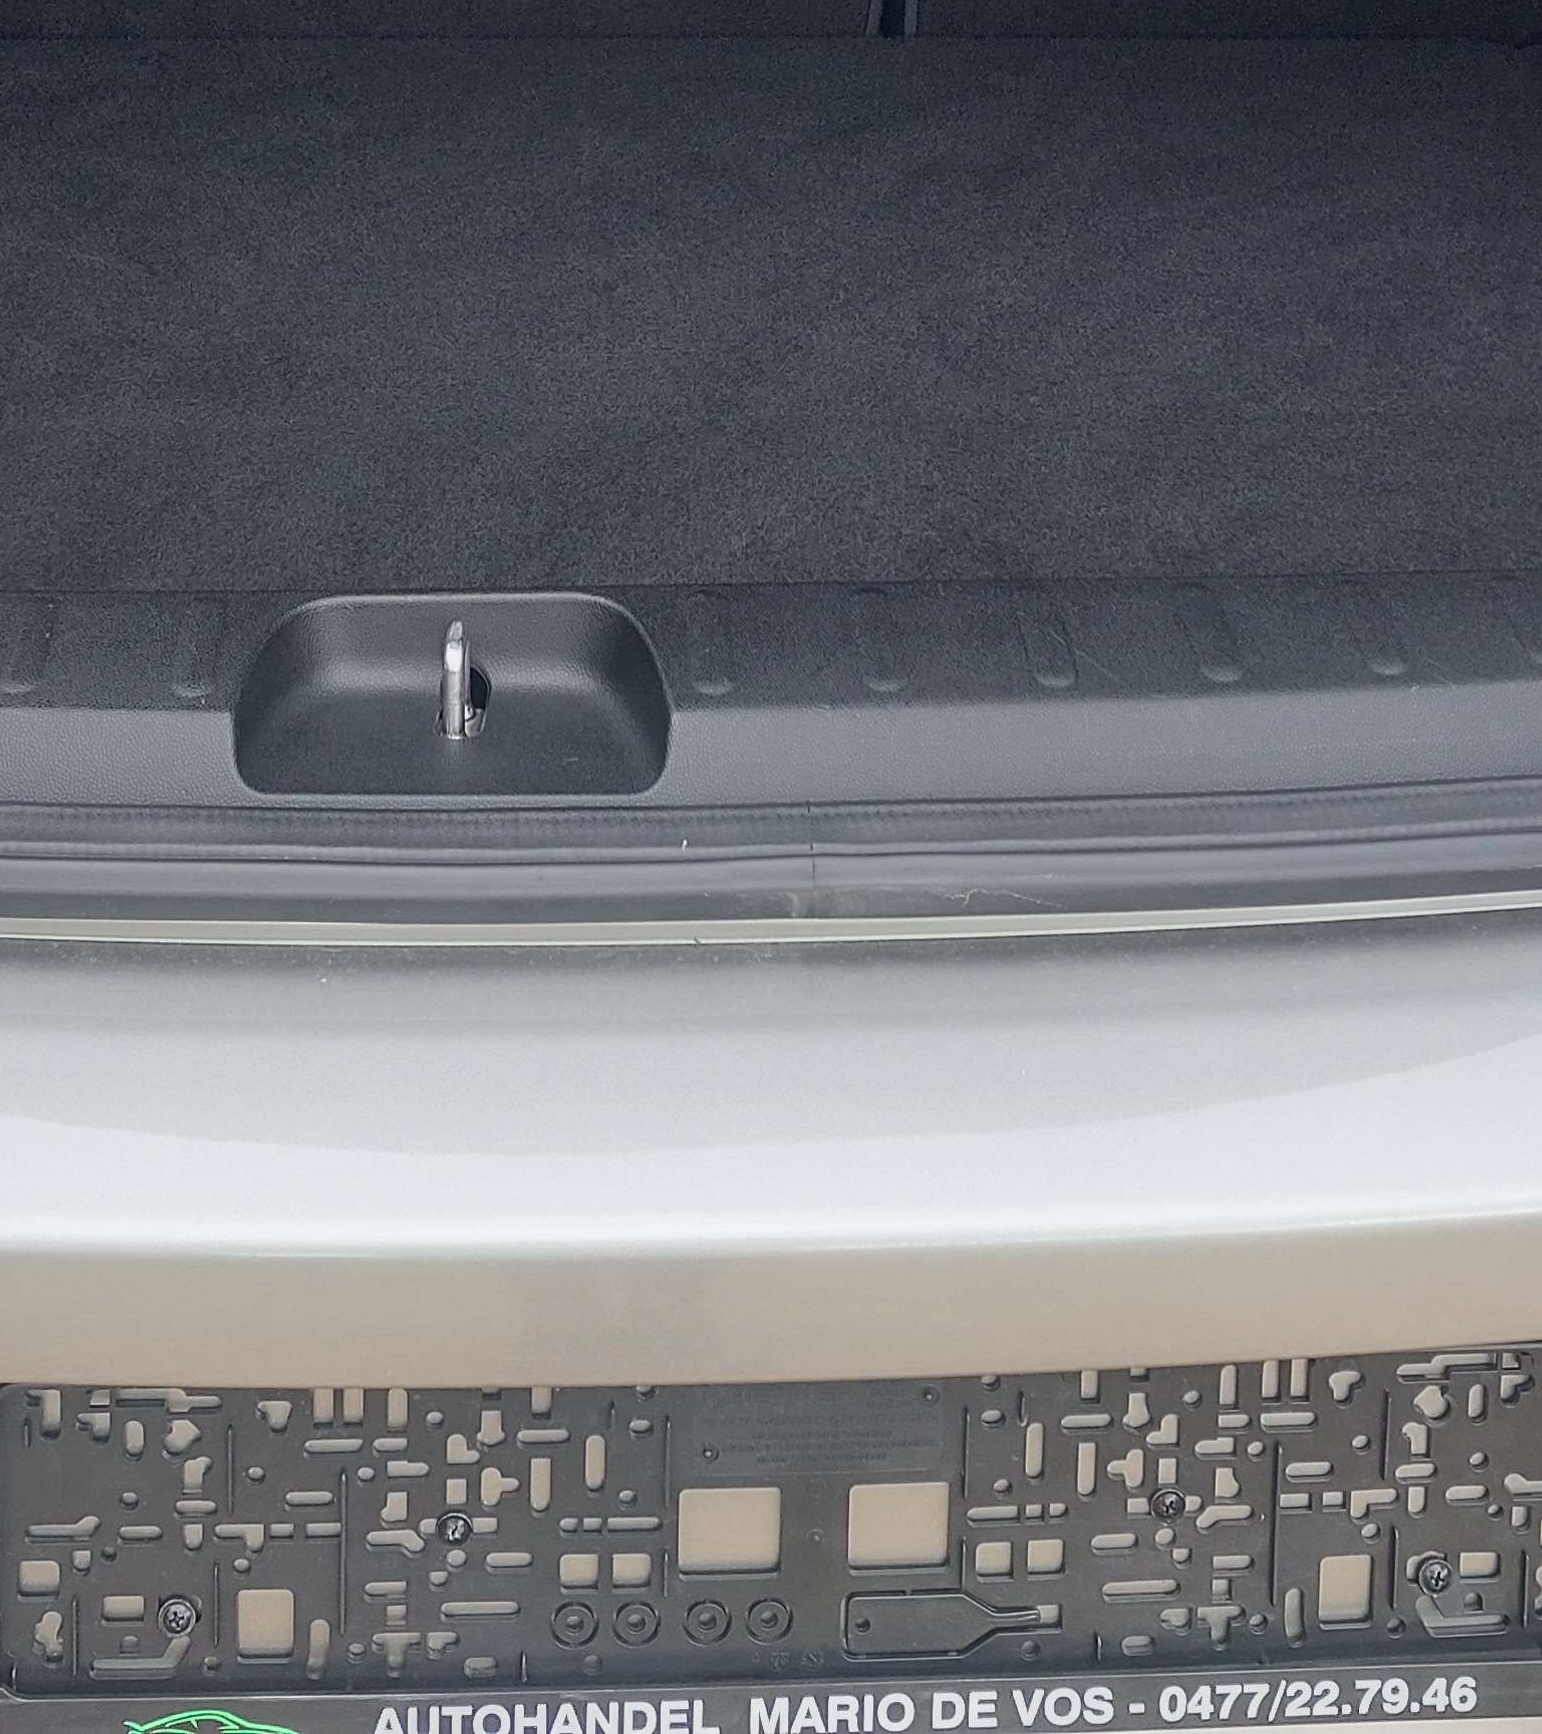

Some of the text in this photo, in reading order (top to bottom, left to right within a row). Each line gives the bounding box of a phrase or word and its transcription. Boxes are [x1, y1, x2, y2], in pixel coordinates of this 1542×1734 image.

[373, 1699, 721, 1734] AUTOHANDEL
[749, 1692, 916, 1734] MARIO
[931, 1690, 998, 1730] DE
[1012, 1686, 1115, 1728] VOS
[1158, 1676, 1479, 1723] 0477/22.79.46
